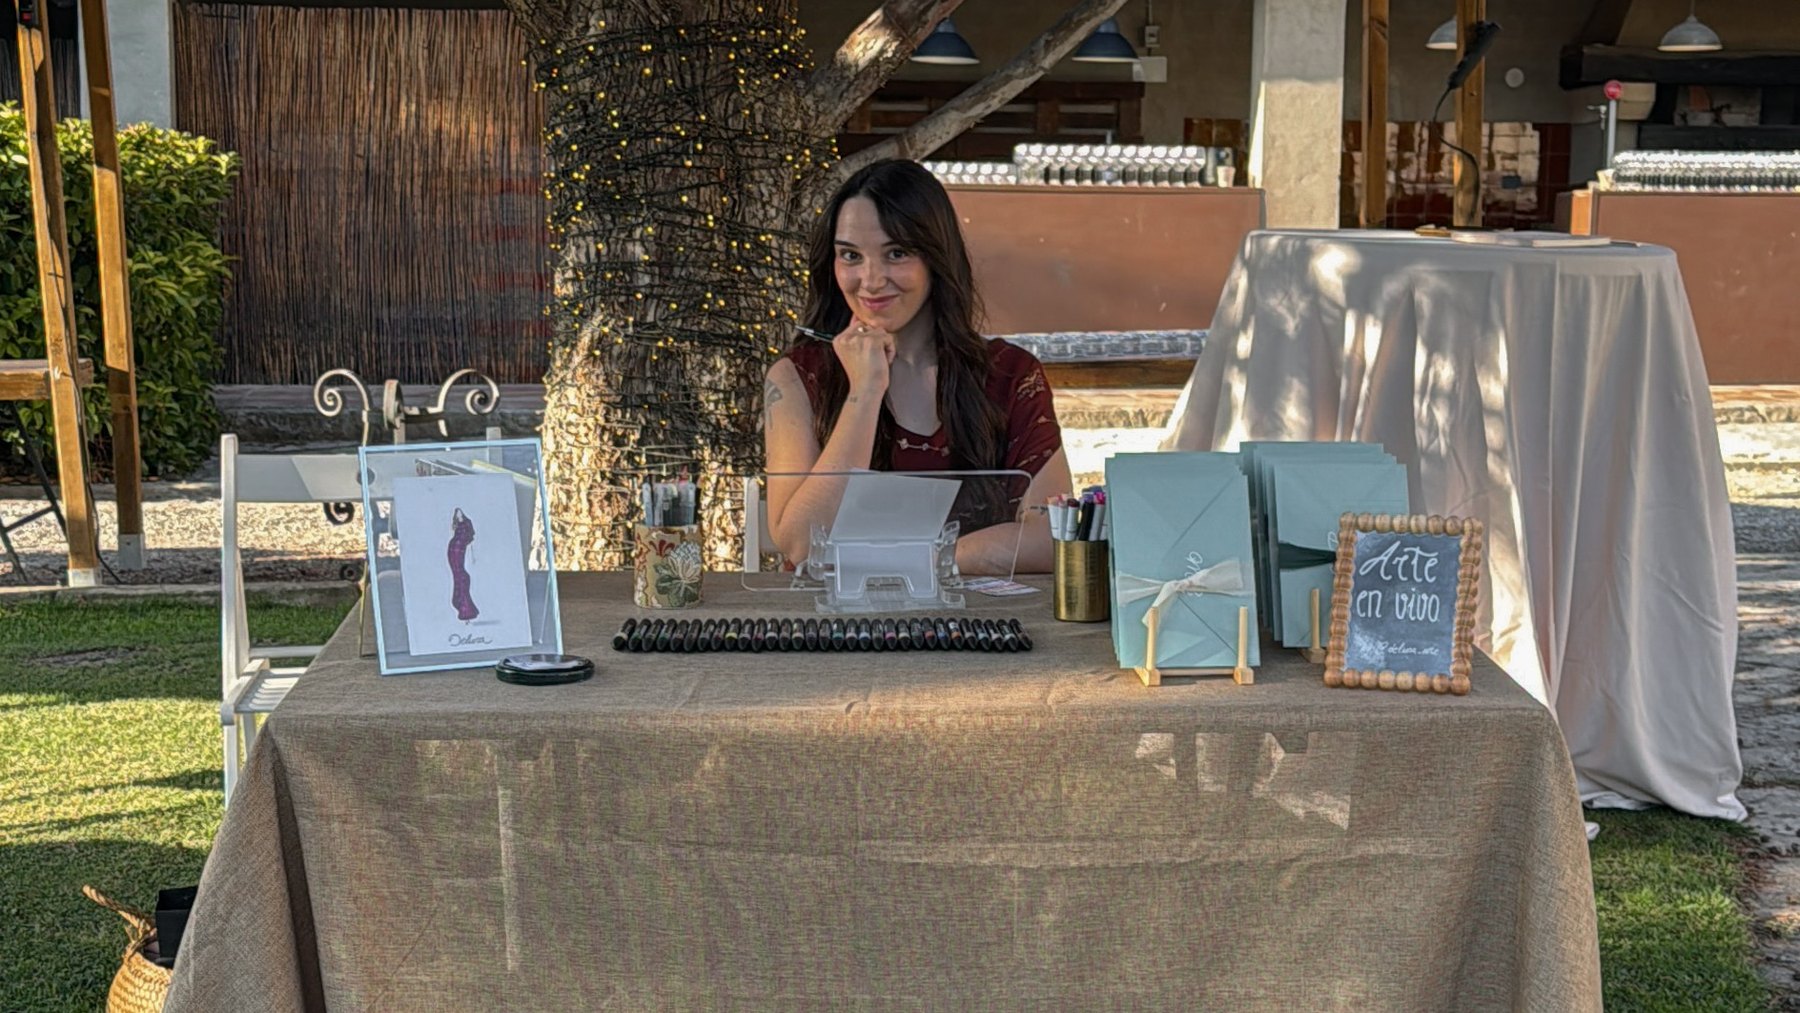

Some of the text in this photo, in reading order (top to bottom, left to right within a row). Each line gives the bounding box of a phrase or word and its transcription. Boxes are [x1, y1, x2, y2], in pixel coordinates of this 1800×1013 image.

[1359, 540, 1439, 583] Arte
[1356, 587, 1440, 622] en vivo
